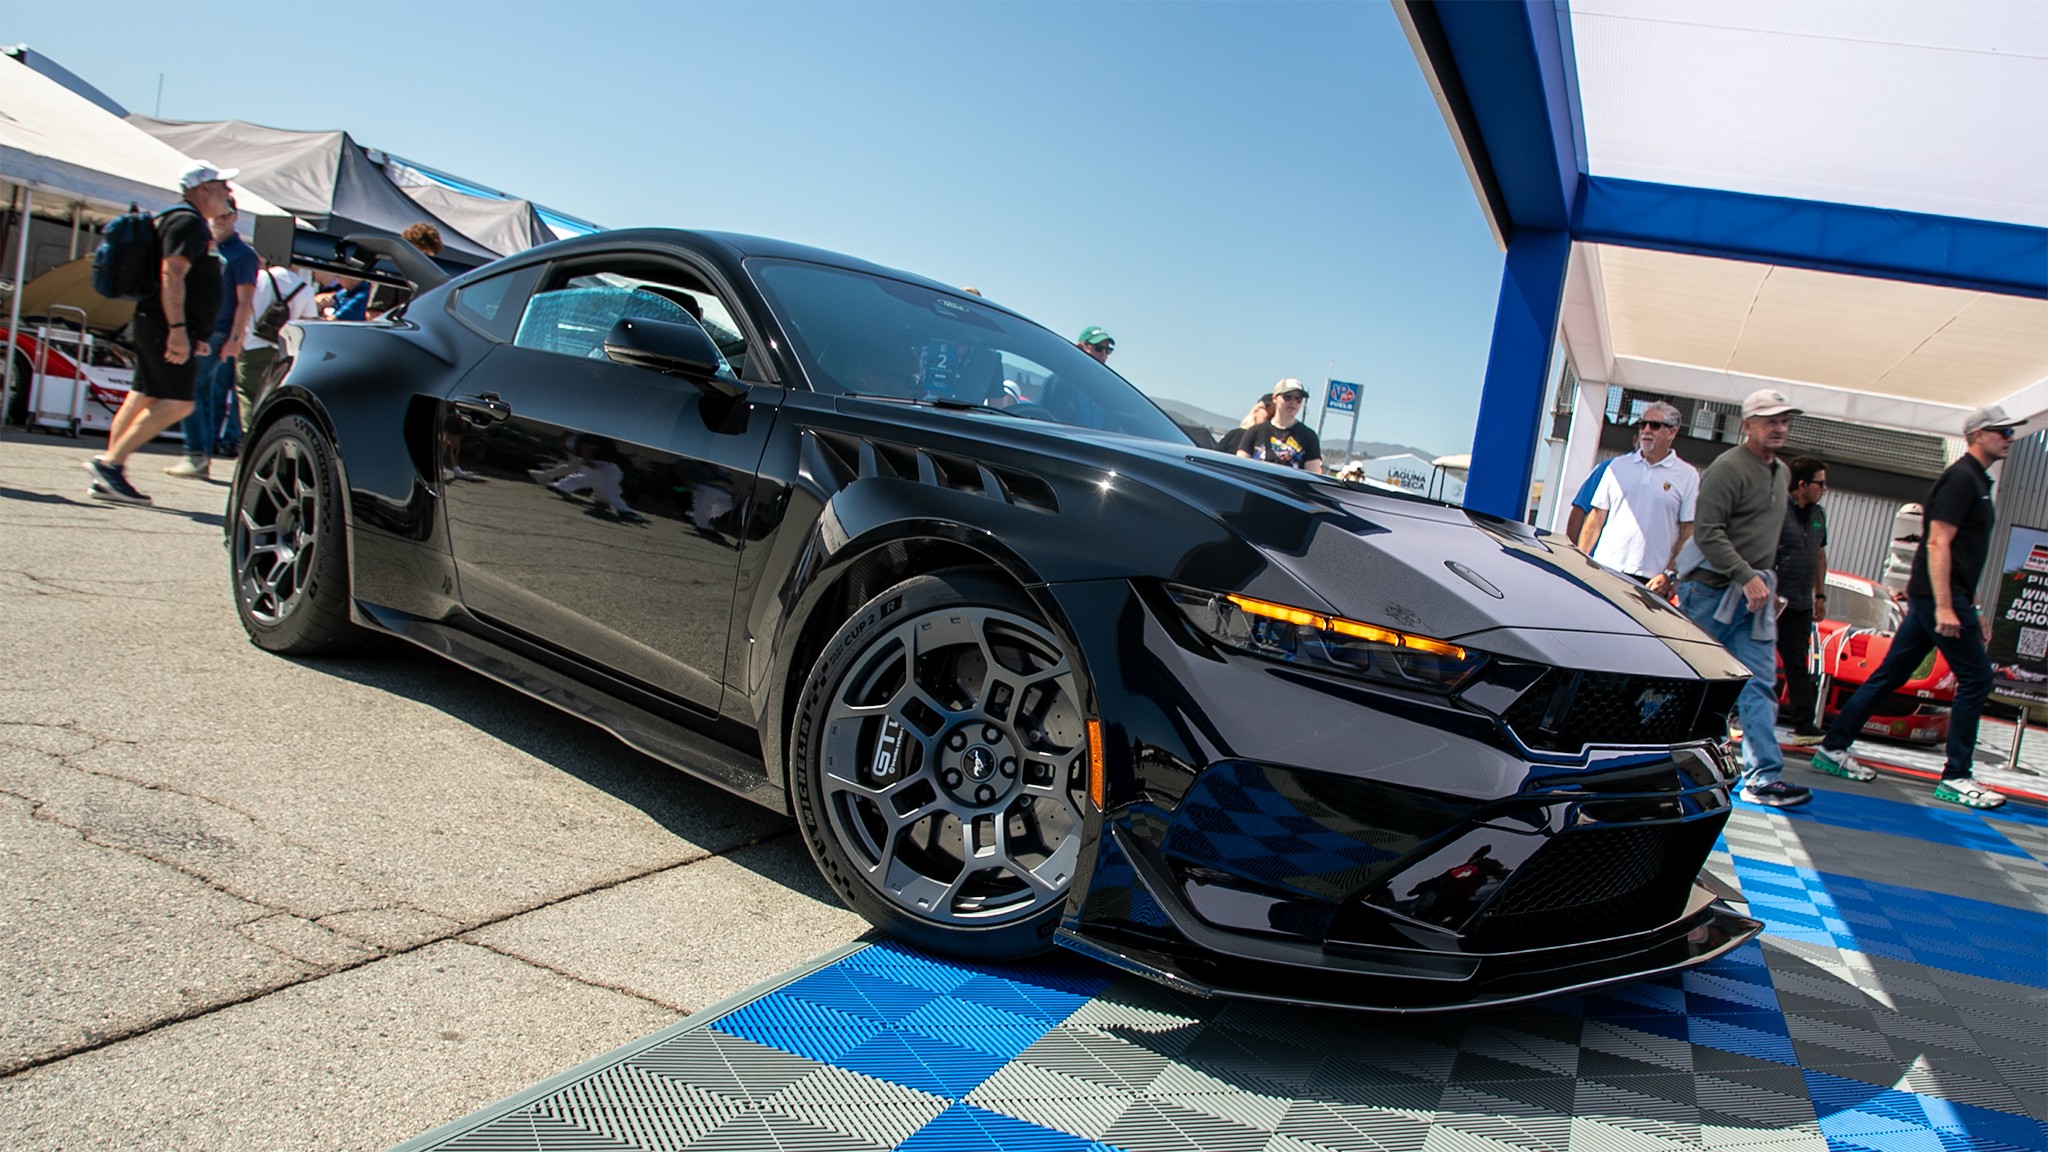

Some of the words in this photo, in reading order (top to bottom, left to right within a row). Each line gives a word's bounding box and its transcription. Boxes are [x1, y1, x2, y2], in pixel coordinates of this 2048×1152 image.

[937, 354, 947, 368] 2
[1330, 401, 1353, 410] FUELS
[1388, 470, 1426, 483] LAGUNA
[1401, 480, 1425, 491] SECA
[2011, 598, 2048, 615] RACI
[845, 621, 867, 646] CUP
[868, 614, 876, 626] 2
[887, 601, 896, 613] R
[2005, 609, 2048, 626] SCHO
[799, 720, 815, 825] MICHELIN
